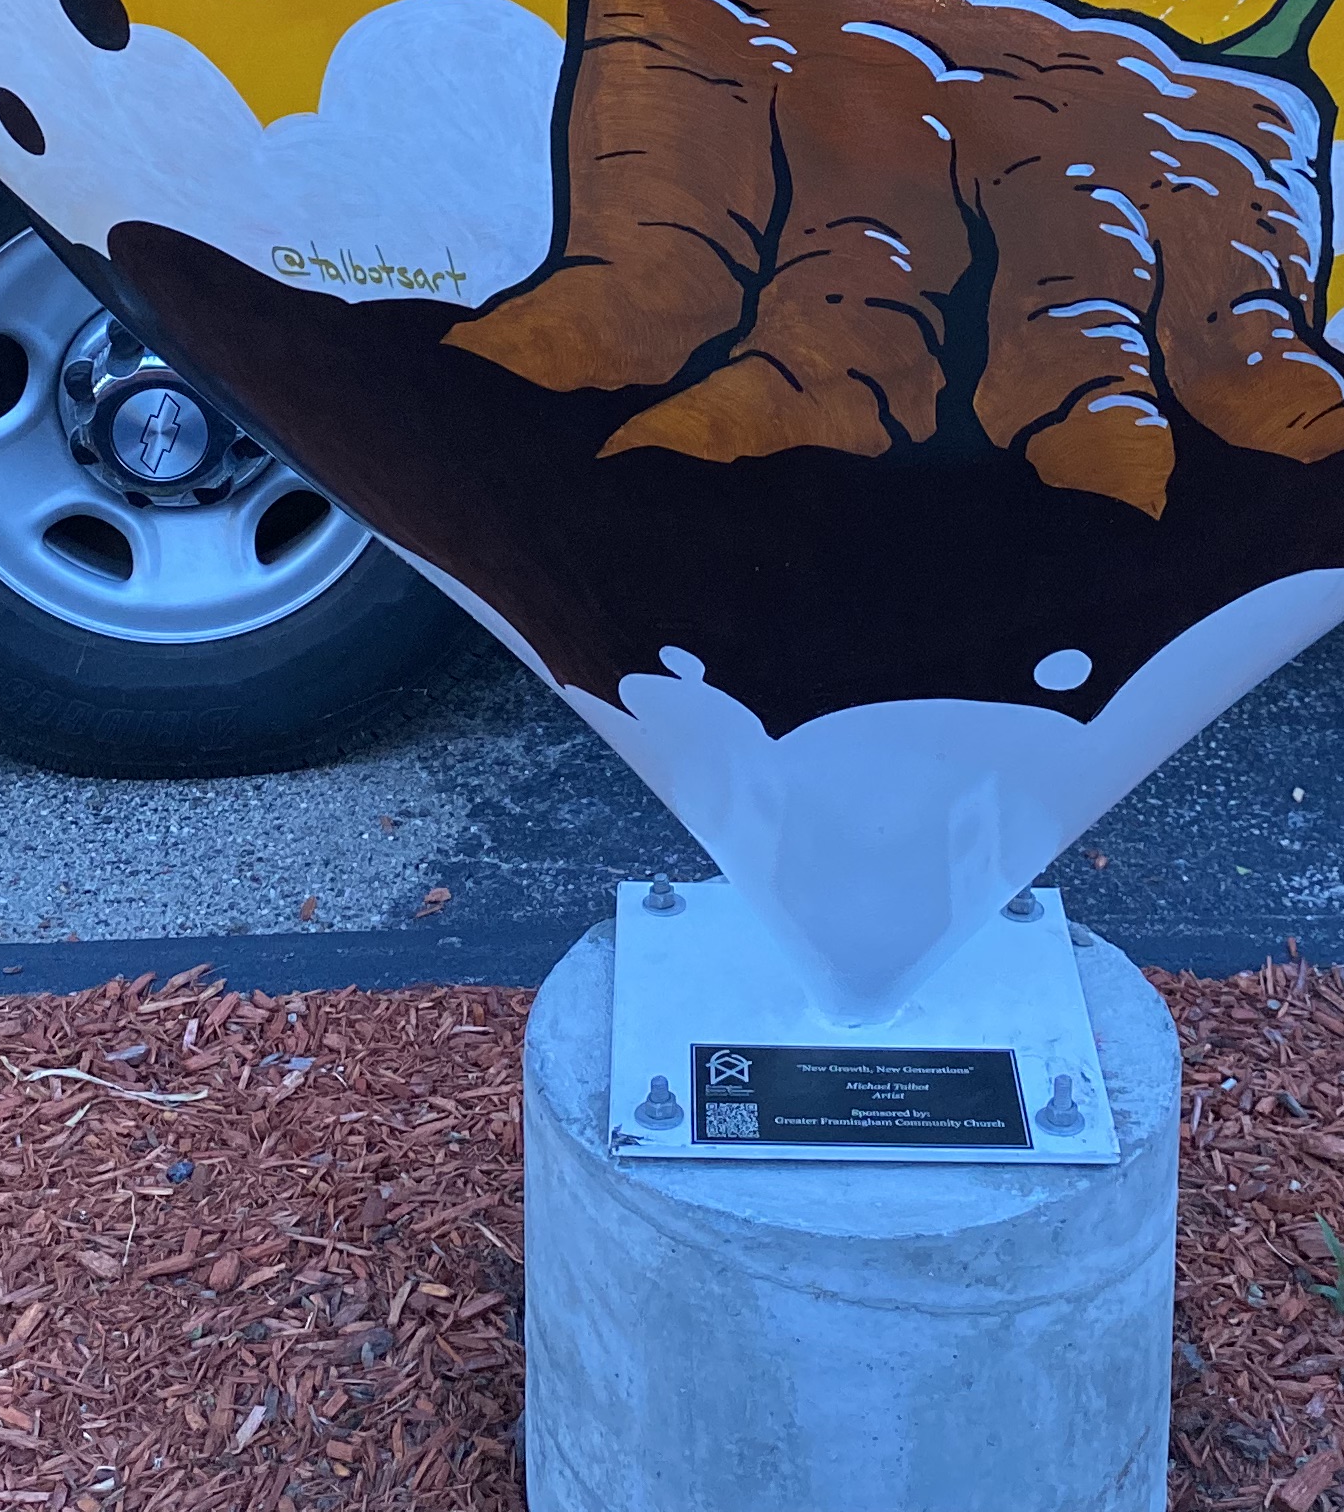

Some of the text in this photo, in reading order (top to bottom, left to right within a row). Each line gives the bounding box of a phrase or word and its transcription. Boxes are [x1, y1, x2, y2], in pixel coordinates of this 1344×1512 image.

[271, 240, 467, 298] @talbotsart
[829, 1064, 874, 1074] Growth,
[876, 1065, 901, 1074] New
[902, 1066, 975, 1075] Generations"
[846, 1082, 930, 1091] Michael Talbot
[872, 1091, 905, 1100] Artist
[851, 1108, 931, 1119] Sponsored by:
[775, 1116, 1006, 1129] Greater Framingham Community Church
